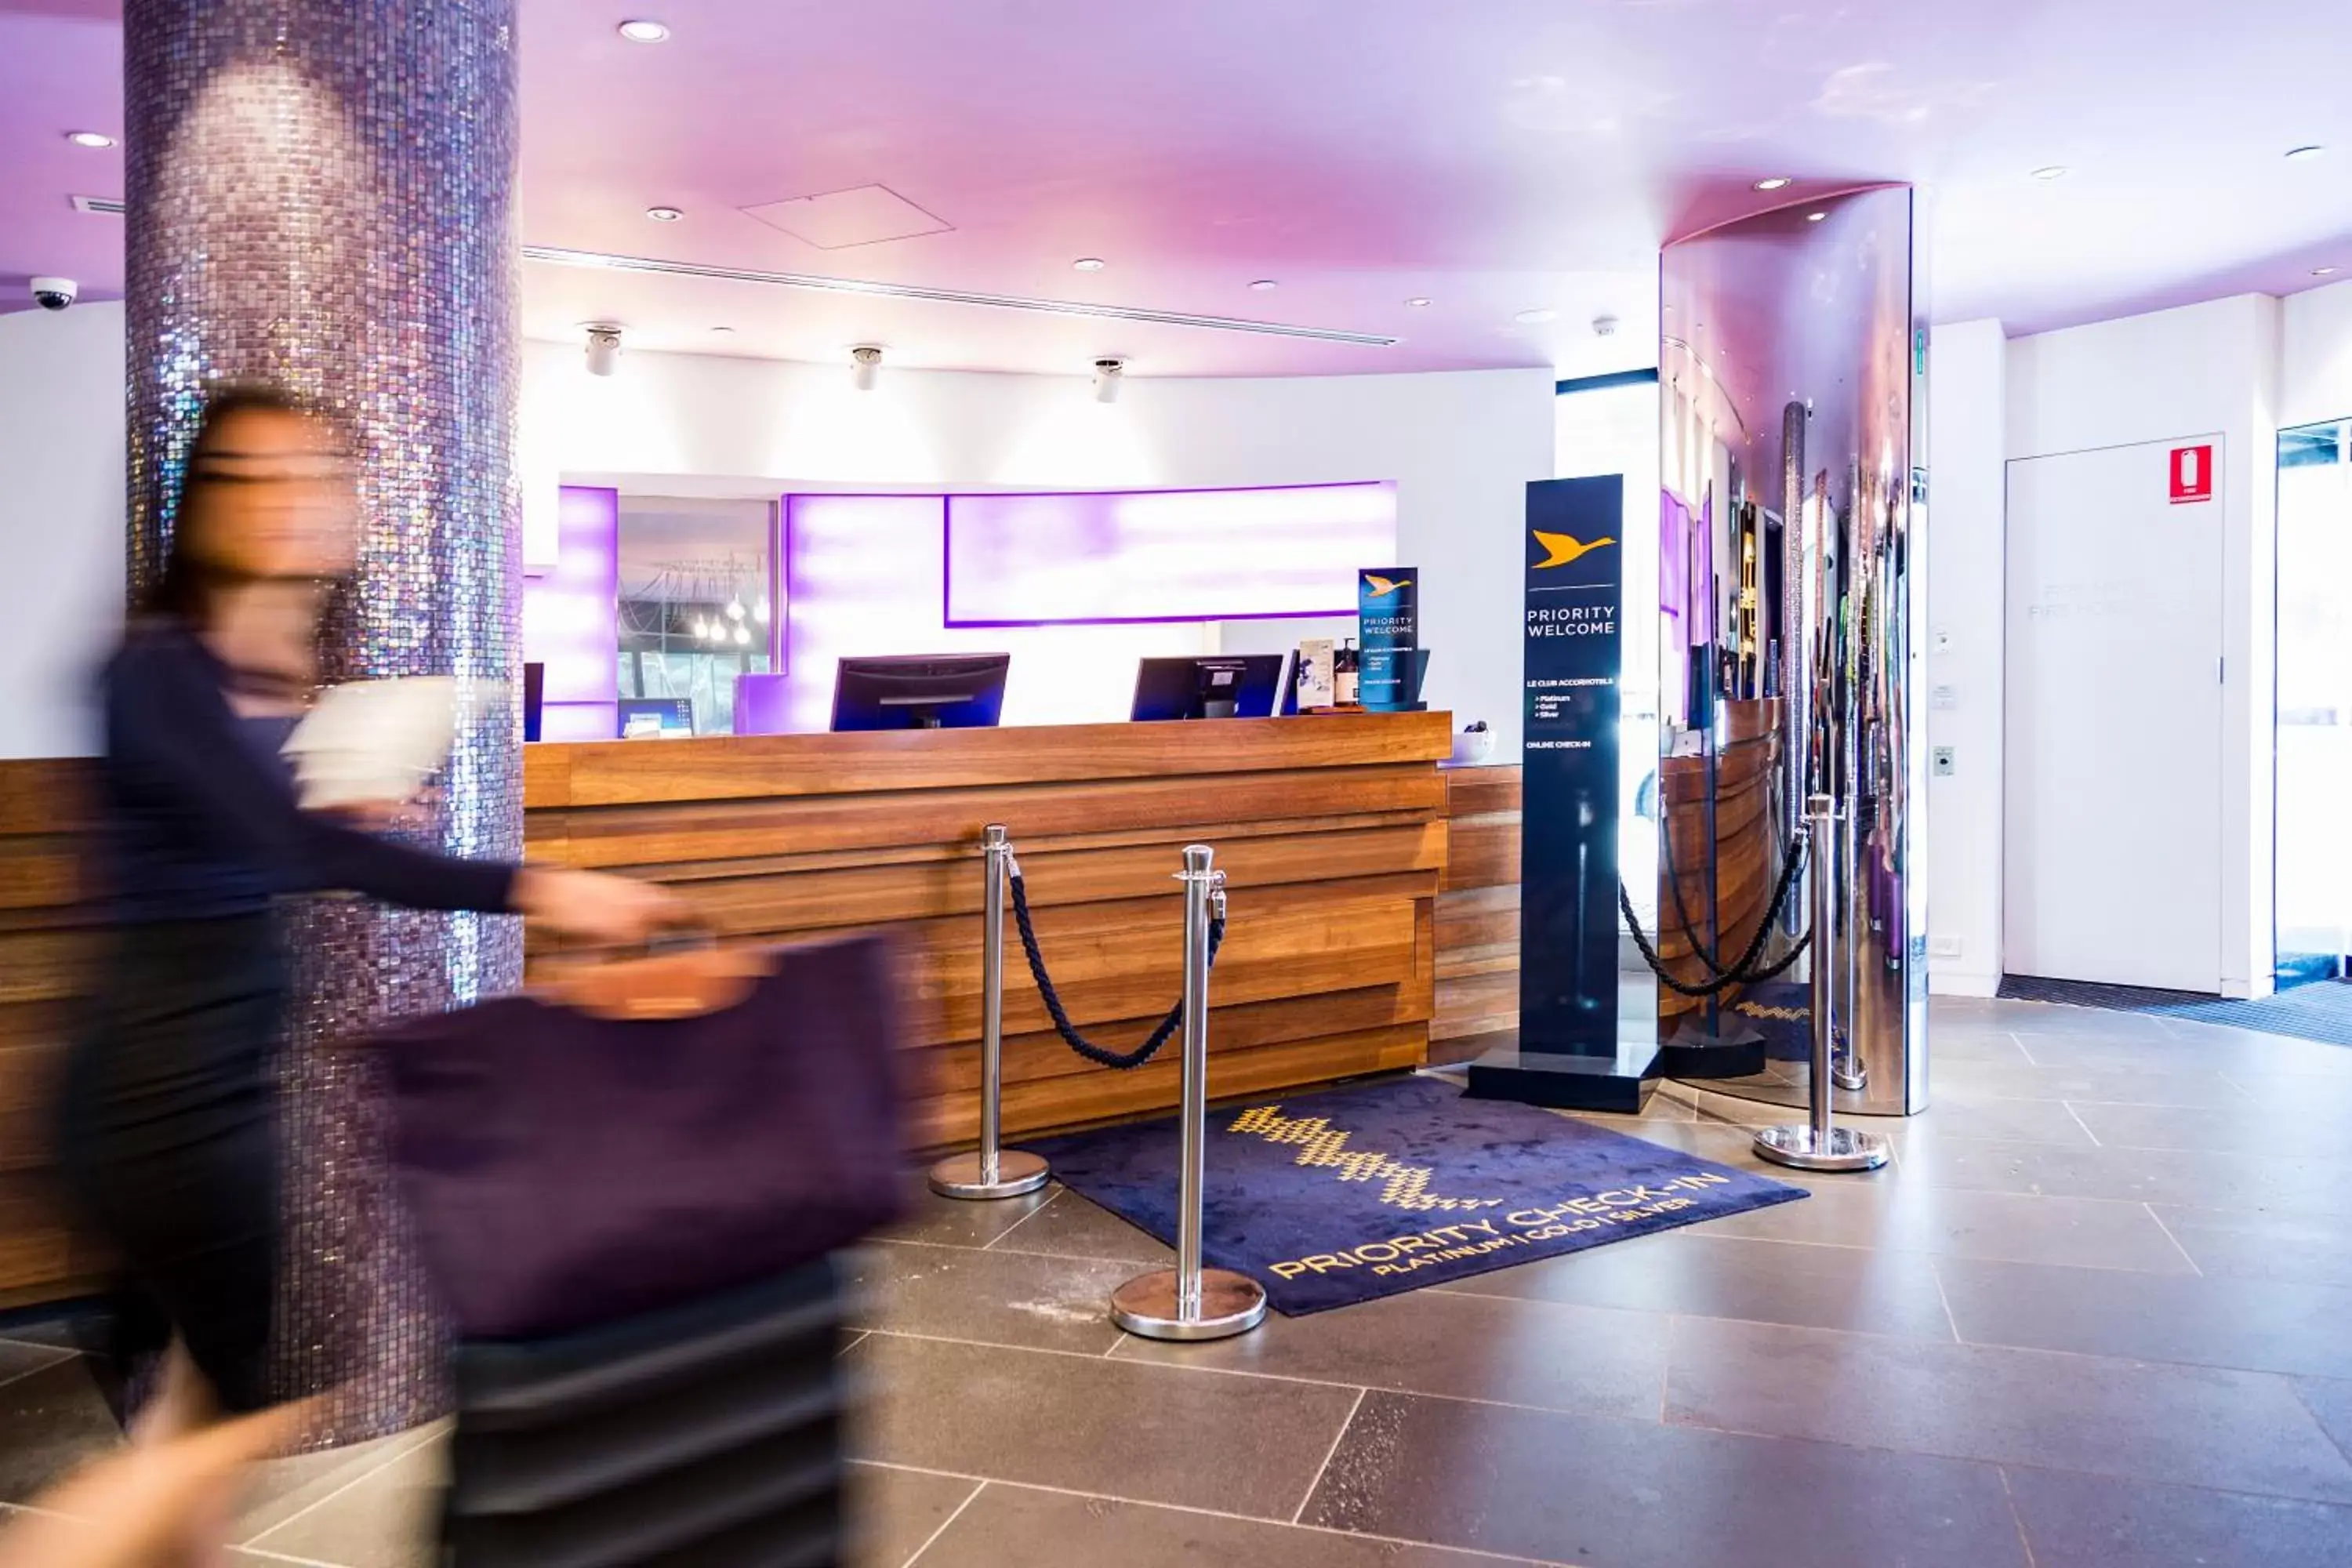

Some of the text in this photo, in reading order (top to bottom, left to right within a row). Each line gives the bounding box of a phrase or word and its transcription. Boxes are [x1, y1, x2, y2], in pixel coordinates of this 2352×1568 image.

[1363, 617, 1413, 626] PRIORITY
[1527, 606, 1615, 622] PRIORITY
[1364, 626, 1413, 634] WELCOME
[1528, 622, 1615, 637] WELCOME
[1269, 1172, 1730, 1280] PRIORITY CHECK-IN
[1372, 1235, 1515, 1276] PLATINUM
[1526, 1216, 1600, 1240] GOLD
[1610, 1197, 1699, 1222] SILVER
